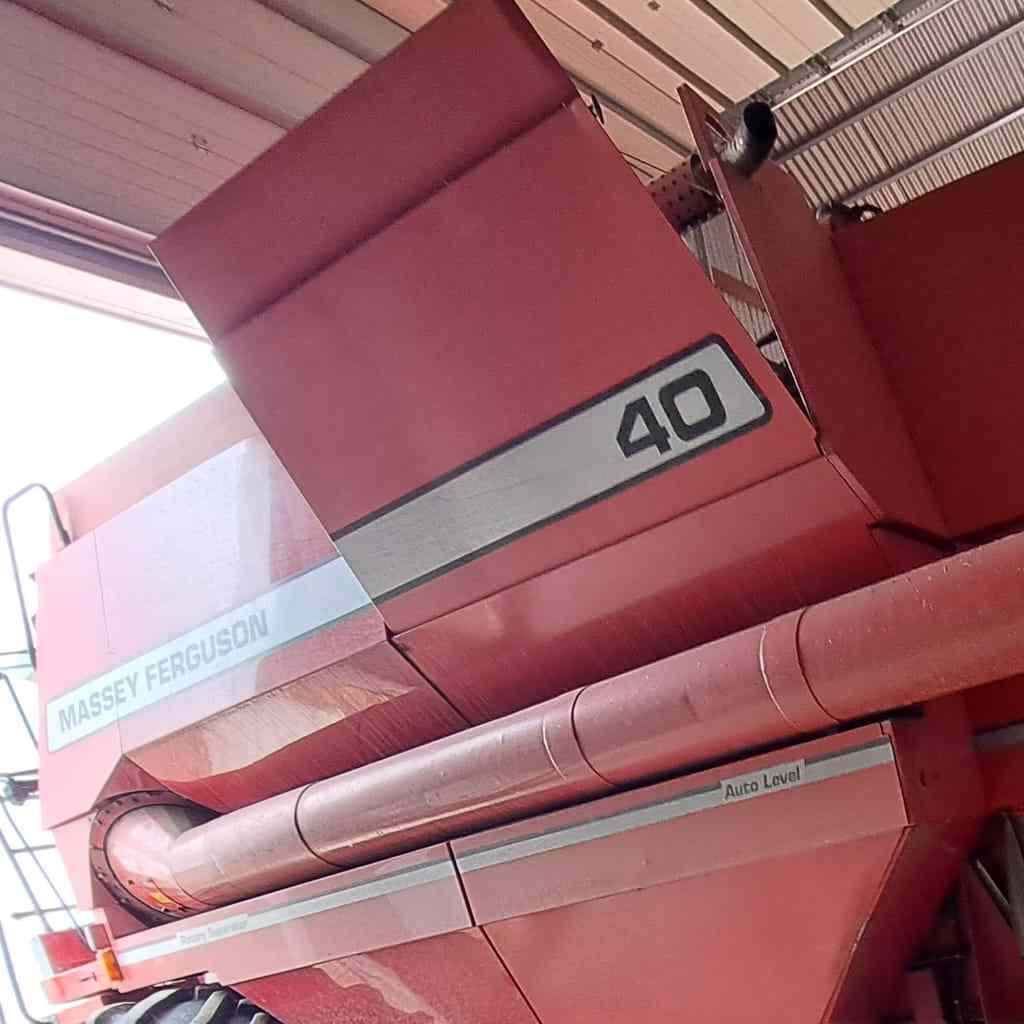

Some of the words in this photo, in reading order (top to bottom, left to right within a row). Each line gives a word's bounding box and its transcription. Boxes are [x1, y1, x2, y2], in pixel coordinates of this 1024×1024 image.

[616, 368, 727, 459] 40
[58, 671, 144, 733] MASSEY
[144, 610, 270, 692] FERGUSON
[725, 782, 759, 800] Auto
[764, 764, 801, 789] Level
